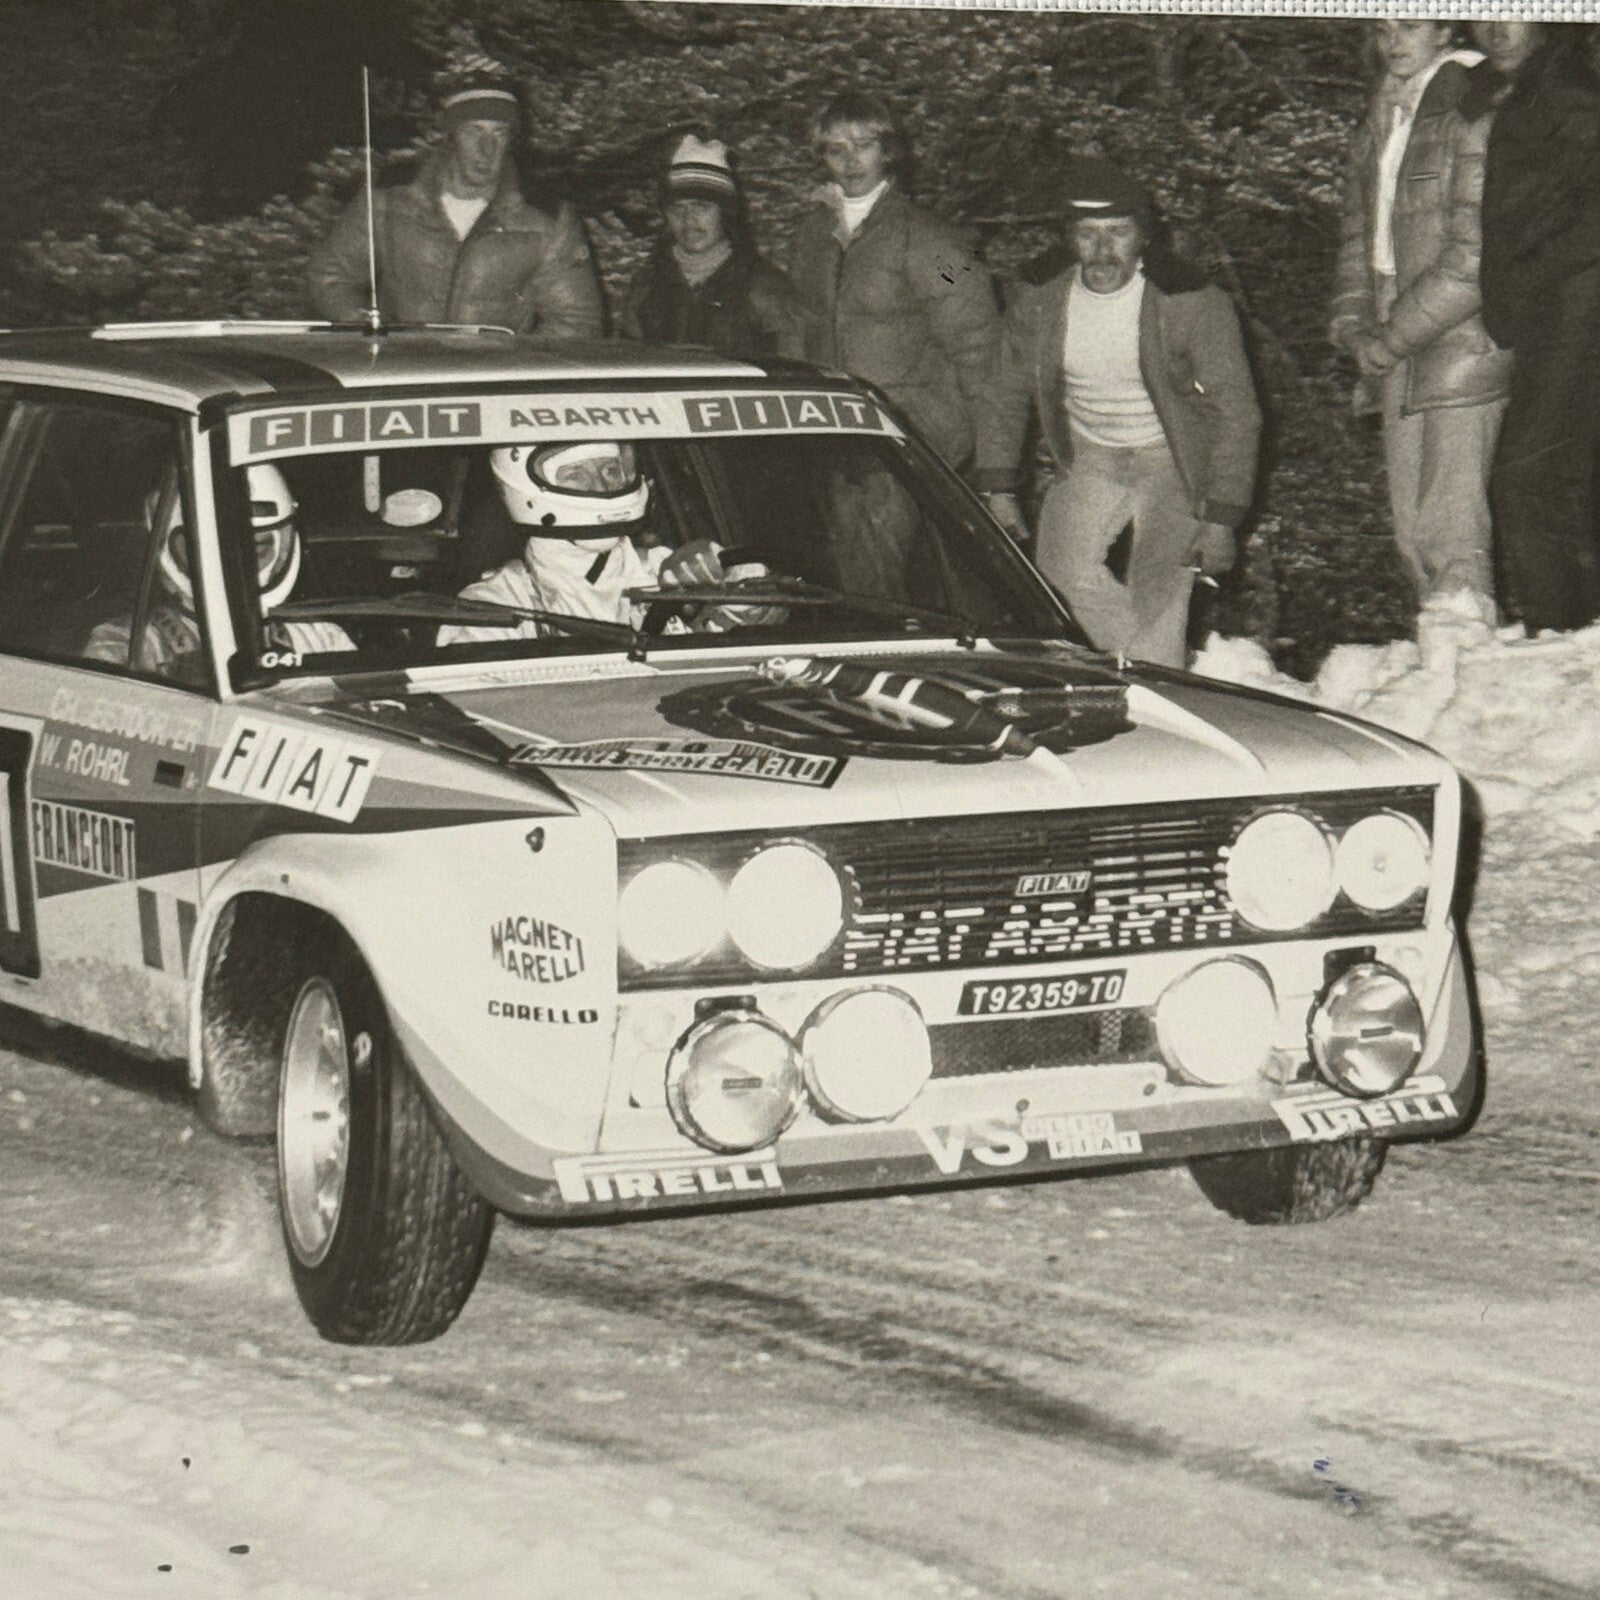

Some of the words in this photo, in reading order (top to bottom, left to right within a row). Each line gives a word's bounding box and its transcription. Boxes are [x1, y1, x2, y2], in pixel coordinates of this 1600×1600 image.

[268, 408, 469, 447] FIAT
[509, 406, 659, 429] ABARTH
[697, 400, 867, 429] FIAT
[222, 728, 369, 808] FIAT
[1023, 874, 1087, 894] FIAT
[491, 916, 585, 960] MAGNETI
[843, 907, 985, 970] FIAT
[986, 889, 1233, 958] ABARTH
[491, 945, 585, 983] MARELLI
[488, 1000, 598, 1024] CARELLO
[1270, 1075, 1459, 1141] PIRELLI
[915, 1123, 1029, 1175] VS
[1056, 1136, 1134, 1154] FIAT
[553, 1147, 783, 1202] PIRELLI
